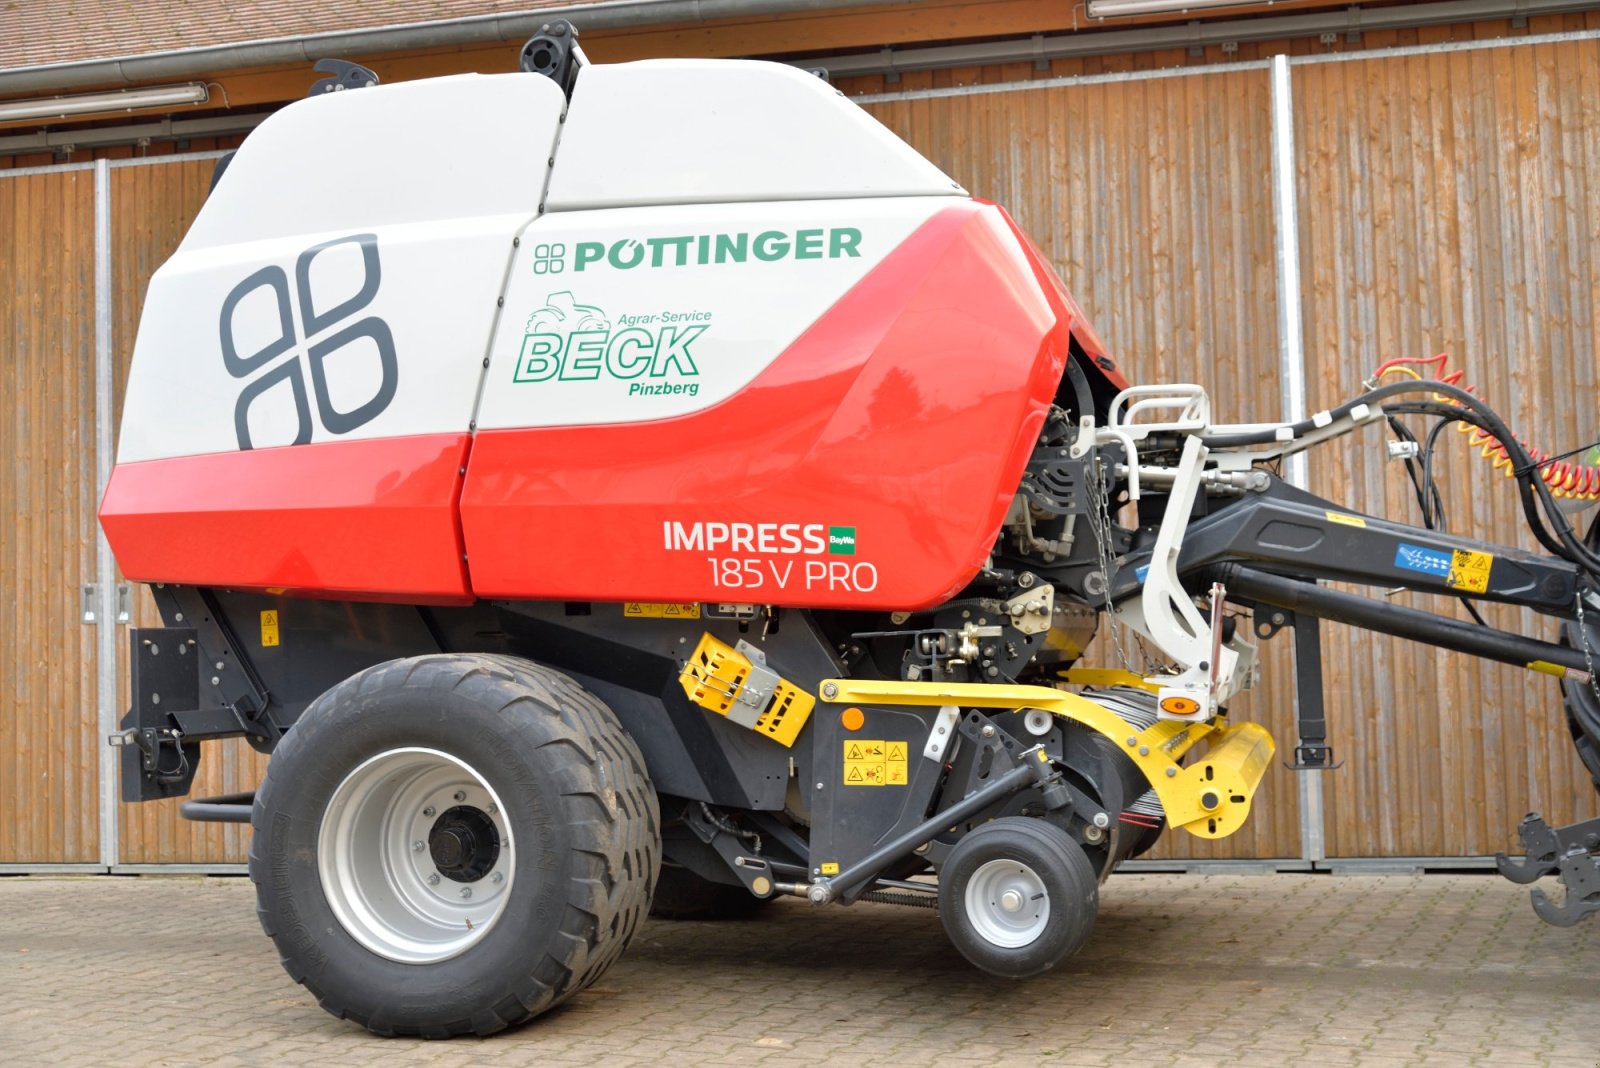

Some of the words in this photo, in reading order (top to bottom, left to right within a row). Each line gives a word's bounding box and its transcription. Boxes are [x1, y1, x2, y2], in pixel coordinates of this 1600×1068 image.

[574, 227, 863, 272] PÖTTINGER
[618, 310, 712, 327] Agrar-Service
[512, 324, 712, 384] BECK
[628, 381, 700, 397] Pinzberg
[663, 521, 825, 555] IMPRESS
[829, 535, 855, 546] BayWa
[708, 557, 764, 589] 185
[769, 559, 793, 589] V
[805, 561, 878, 592] PRO
